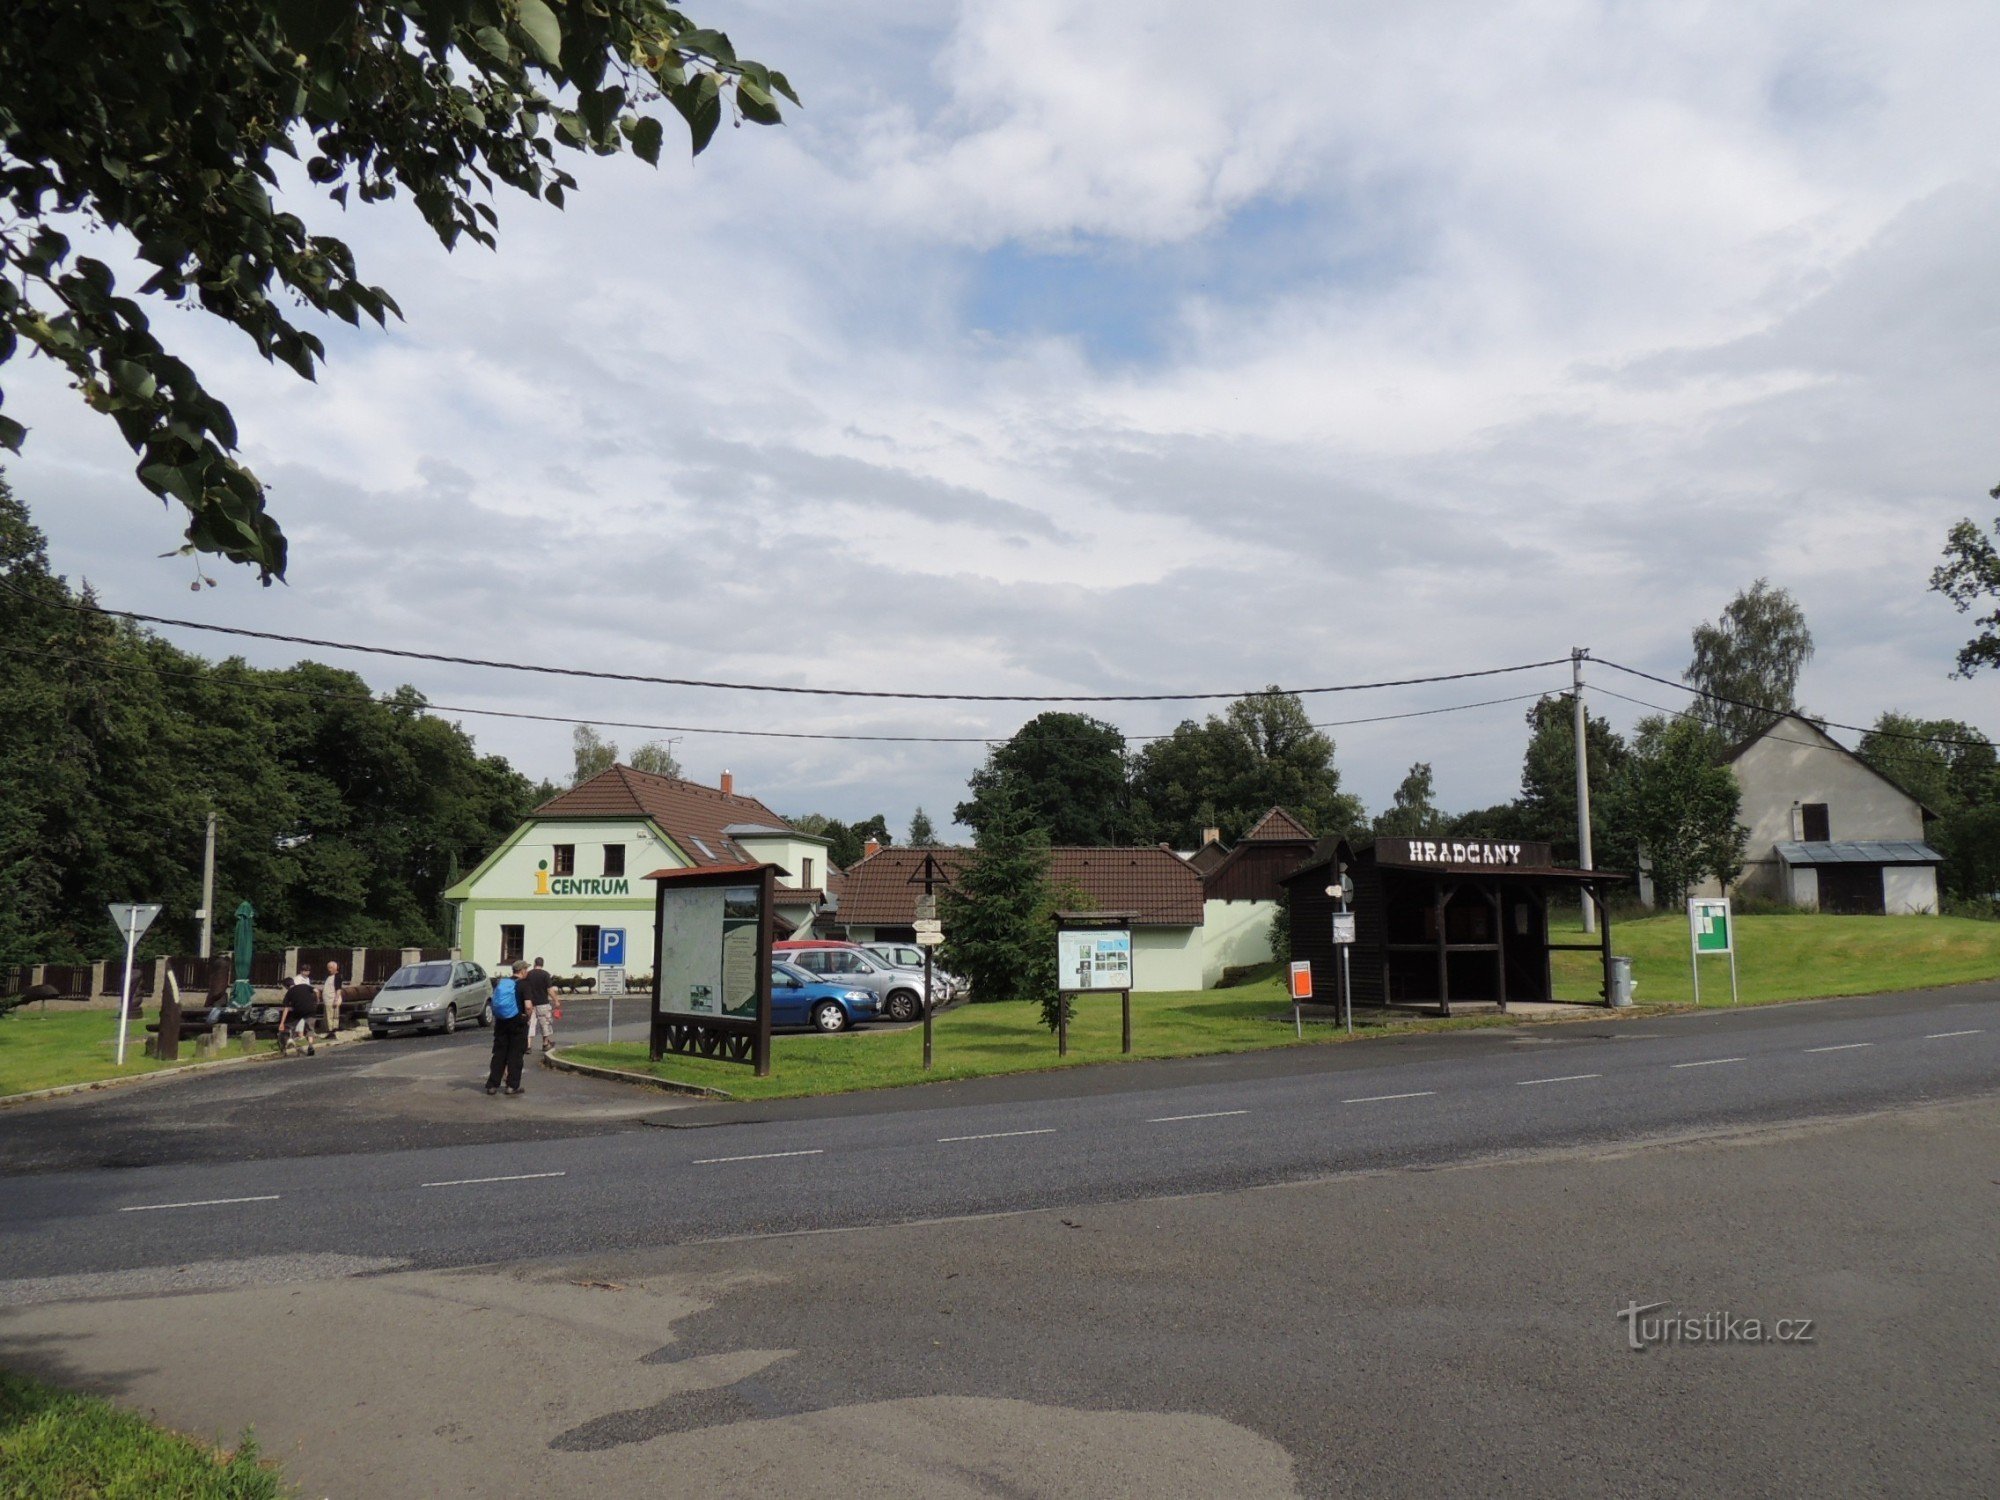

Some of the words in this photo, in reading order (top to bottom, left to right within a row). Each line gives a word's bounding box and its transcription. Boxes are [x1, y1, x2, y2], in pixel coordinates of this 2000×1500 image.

[1408, 841, 1521, 864] HRADČANY
[551, 878, 629, 895] CENTRUM
[603, 932, 620, 954] P
